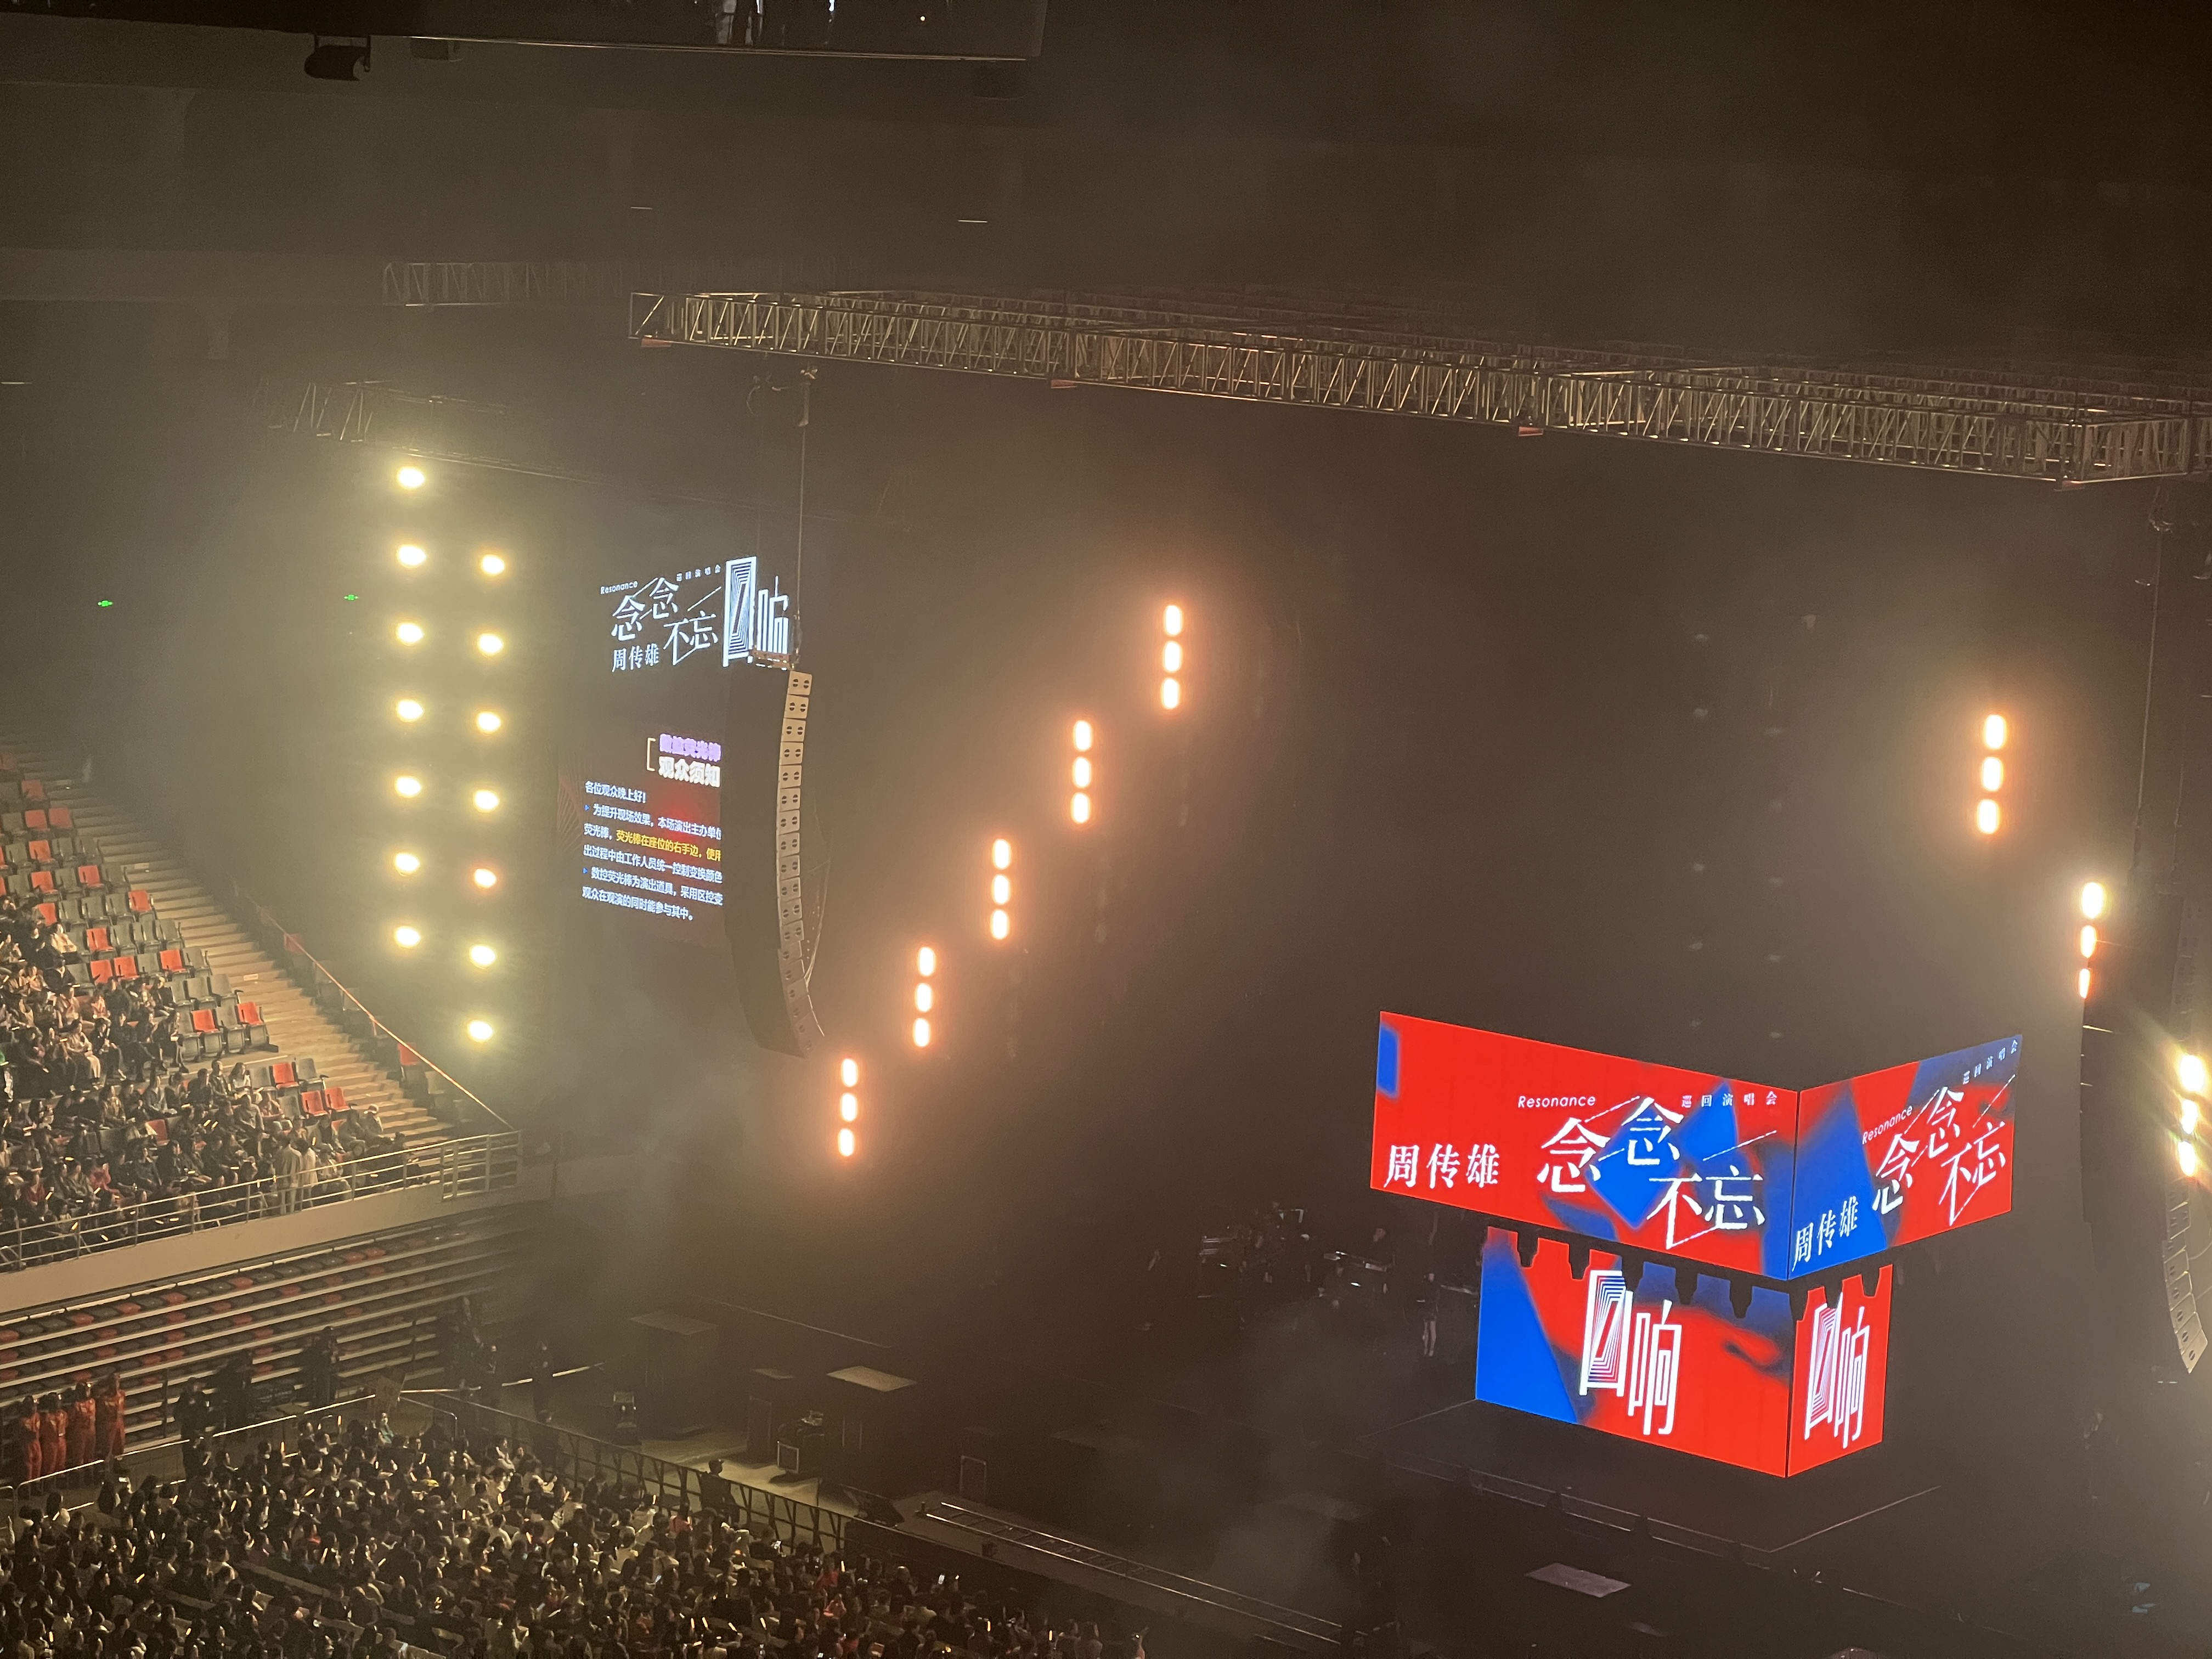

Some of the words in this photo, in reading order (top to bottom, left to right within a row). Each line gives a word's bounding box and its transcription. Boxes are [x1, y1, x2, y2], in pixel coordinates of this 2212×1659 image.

[600, 580, 638, 595] Resonance
[612, 577, 718, 666] 念念不忘
[612, 644, 659, 673] 周传雄
[658, 755, 720, 788] 观众须知
[1518, 1093, 1596, 1109] Resonance
[1681, 1091, 1778, 1108] 巡回演唱会
[1862, 1105, 1913, 1145] Resonance
[1383, 1143, 1500, 1189] 周传雄
[1536, 1096, 1765, 1250] 念念不忘
[1872, 1086, 2006, 1226] 念念不忘
[1792, 1195, 1859, 1272] 周传雄
[1579, 1269, 1683, 1436] 回响
